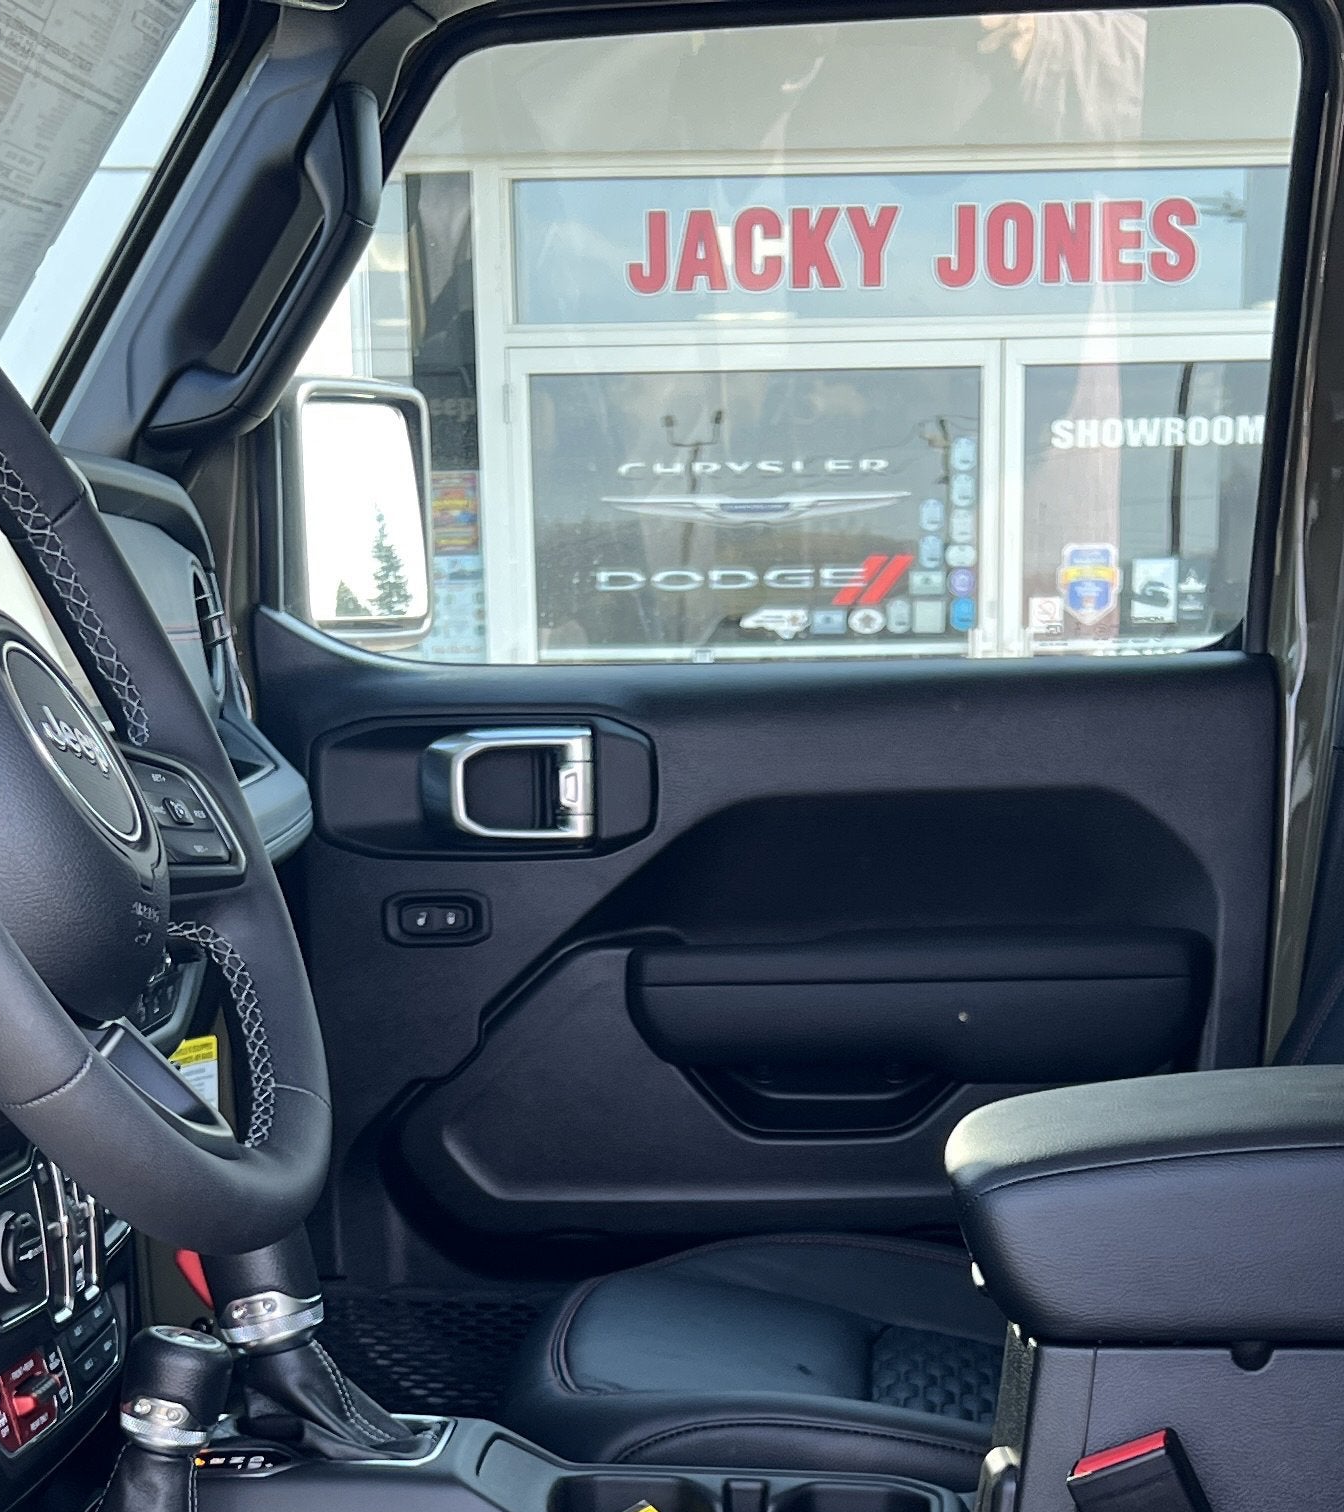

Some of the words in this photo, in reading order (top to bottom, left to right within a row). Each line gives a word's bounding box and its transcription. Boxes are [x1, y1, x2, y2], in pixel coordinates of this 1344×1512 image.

[625, 204, 900, 294] JACKY
[934, 197, 1200, 287] JONES
[1051, 415, 1265, 449] SHOWROOM
[617, 458, 889, 475] CHRYSLER
[596, 567, 867, 592] DODGE
[41, 705, 109, 777] Jeep
